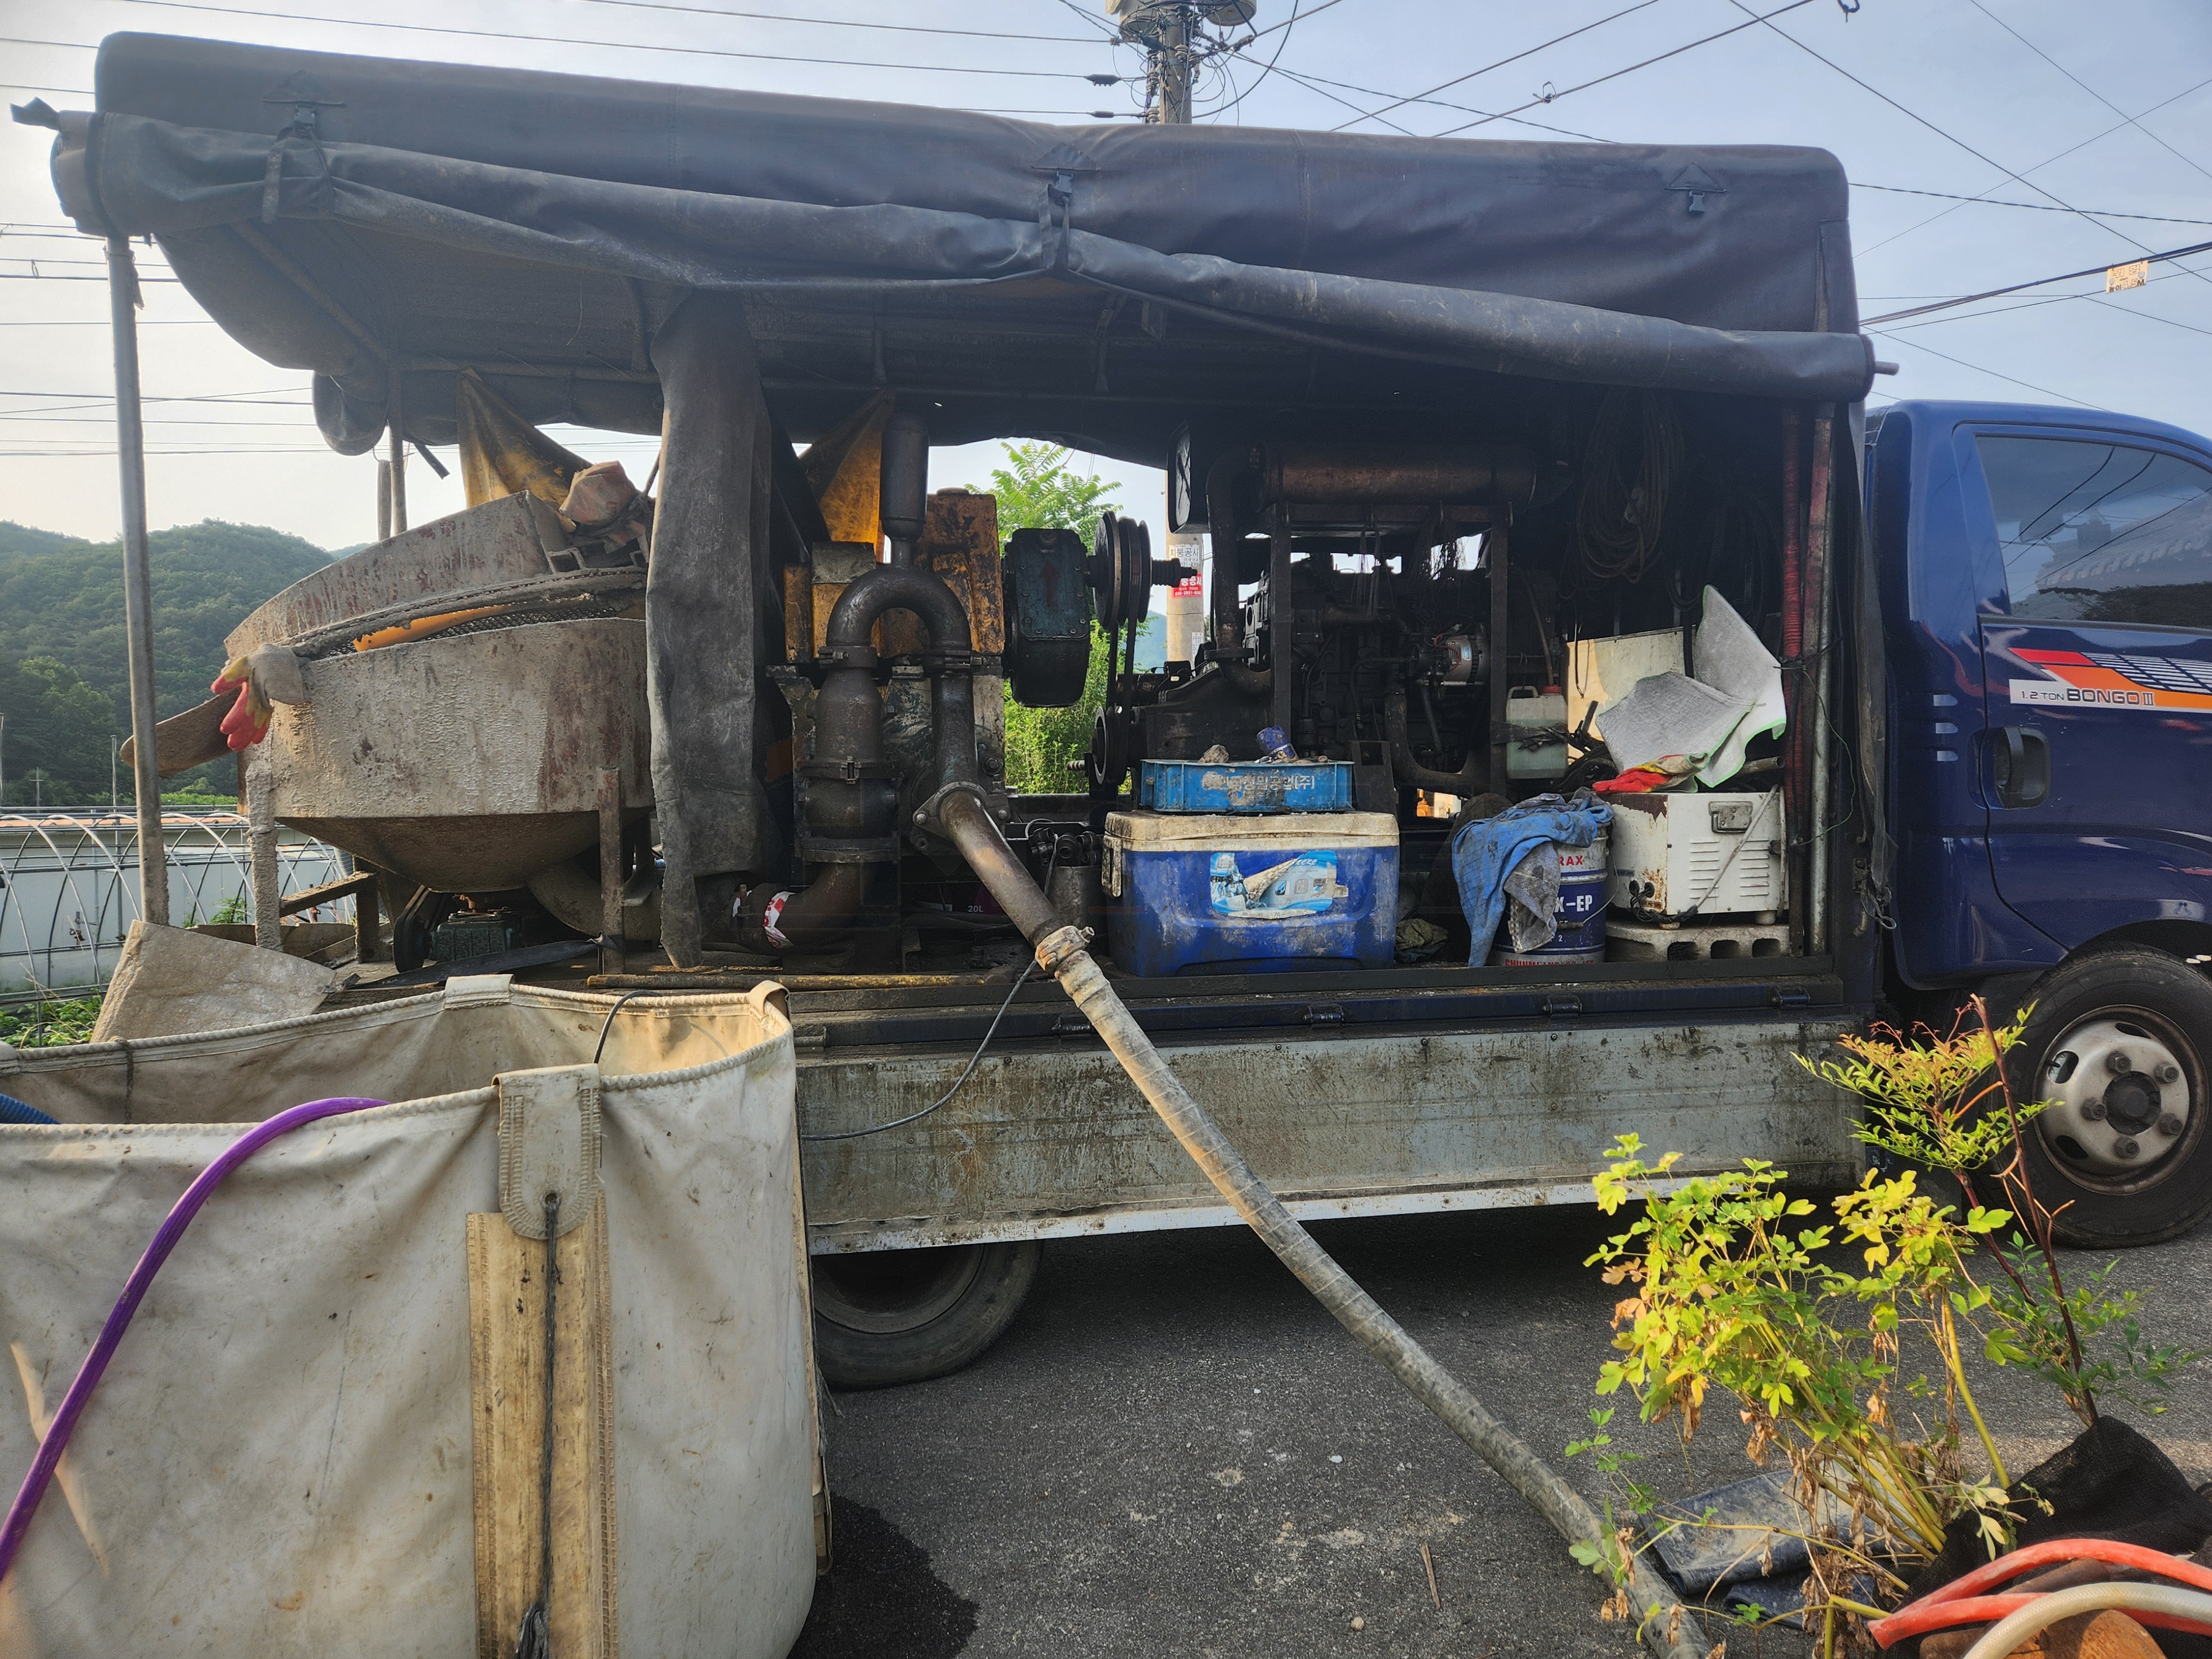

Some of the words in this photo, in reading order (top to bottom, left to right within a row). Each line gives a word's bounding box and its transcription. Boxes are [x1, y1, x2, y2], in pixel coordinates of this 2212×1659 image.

[1170, 548, 1198, 557] 지붕공사
[1181, 576, 1201, 586] 붕공사
[2022, 691, 2038, 699] 1.2
[2041, 692, 2064, 701] TON
[2066, 688, 2140, 705] BONGO
[1559, 855, 1583, 866] RAX
[1554, 895, 1593, 912] X-EP
